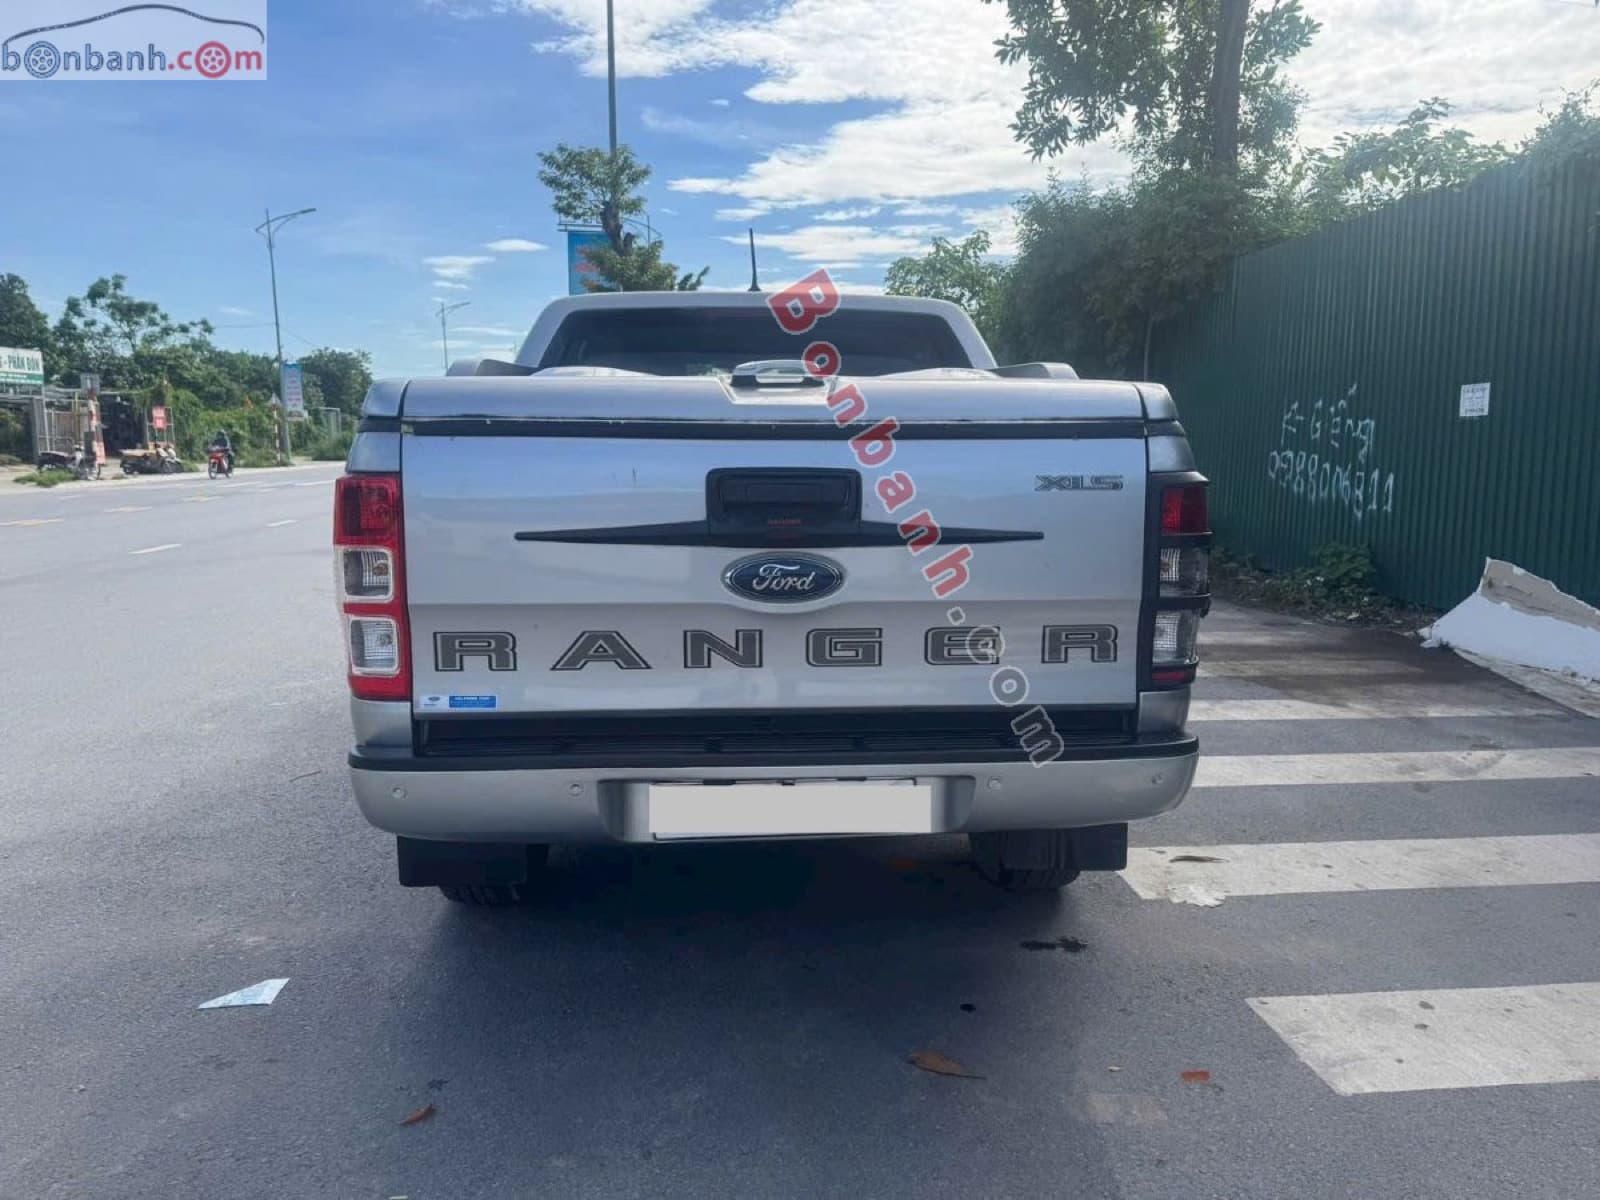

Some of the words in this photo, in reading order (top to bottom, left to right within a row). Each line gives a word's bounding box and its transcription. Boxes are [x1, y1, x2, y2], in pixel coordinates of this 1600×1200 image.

[1034, 474, 1124, 491] XLS
[752, 563, 816, 591] Ford
[433, 624, 1118, 672] RANGER
